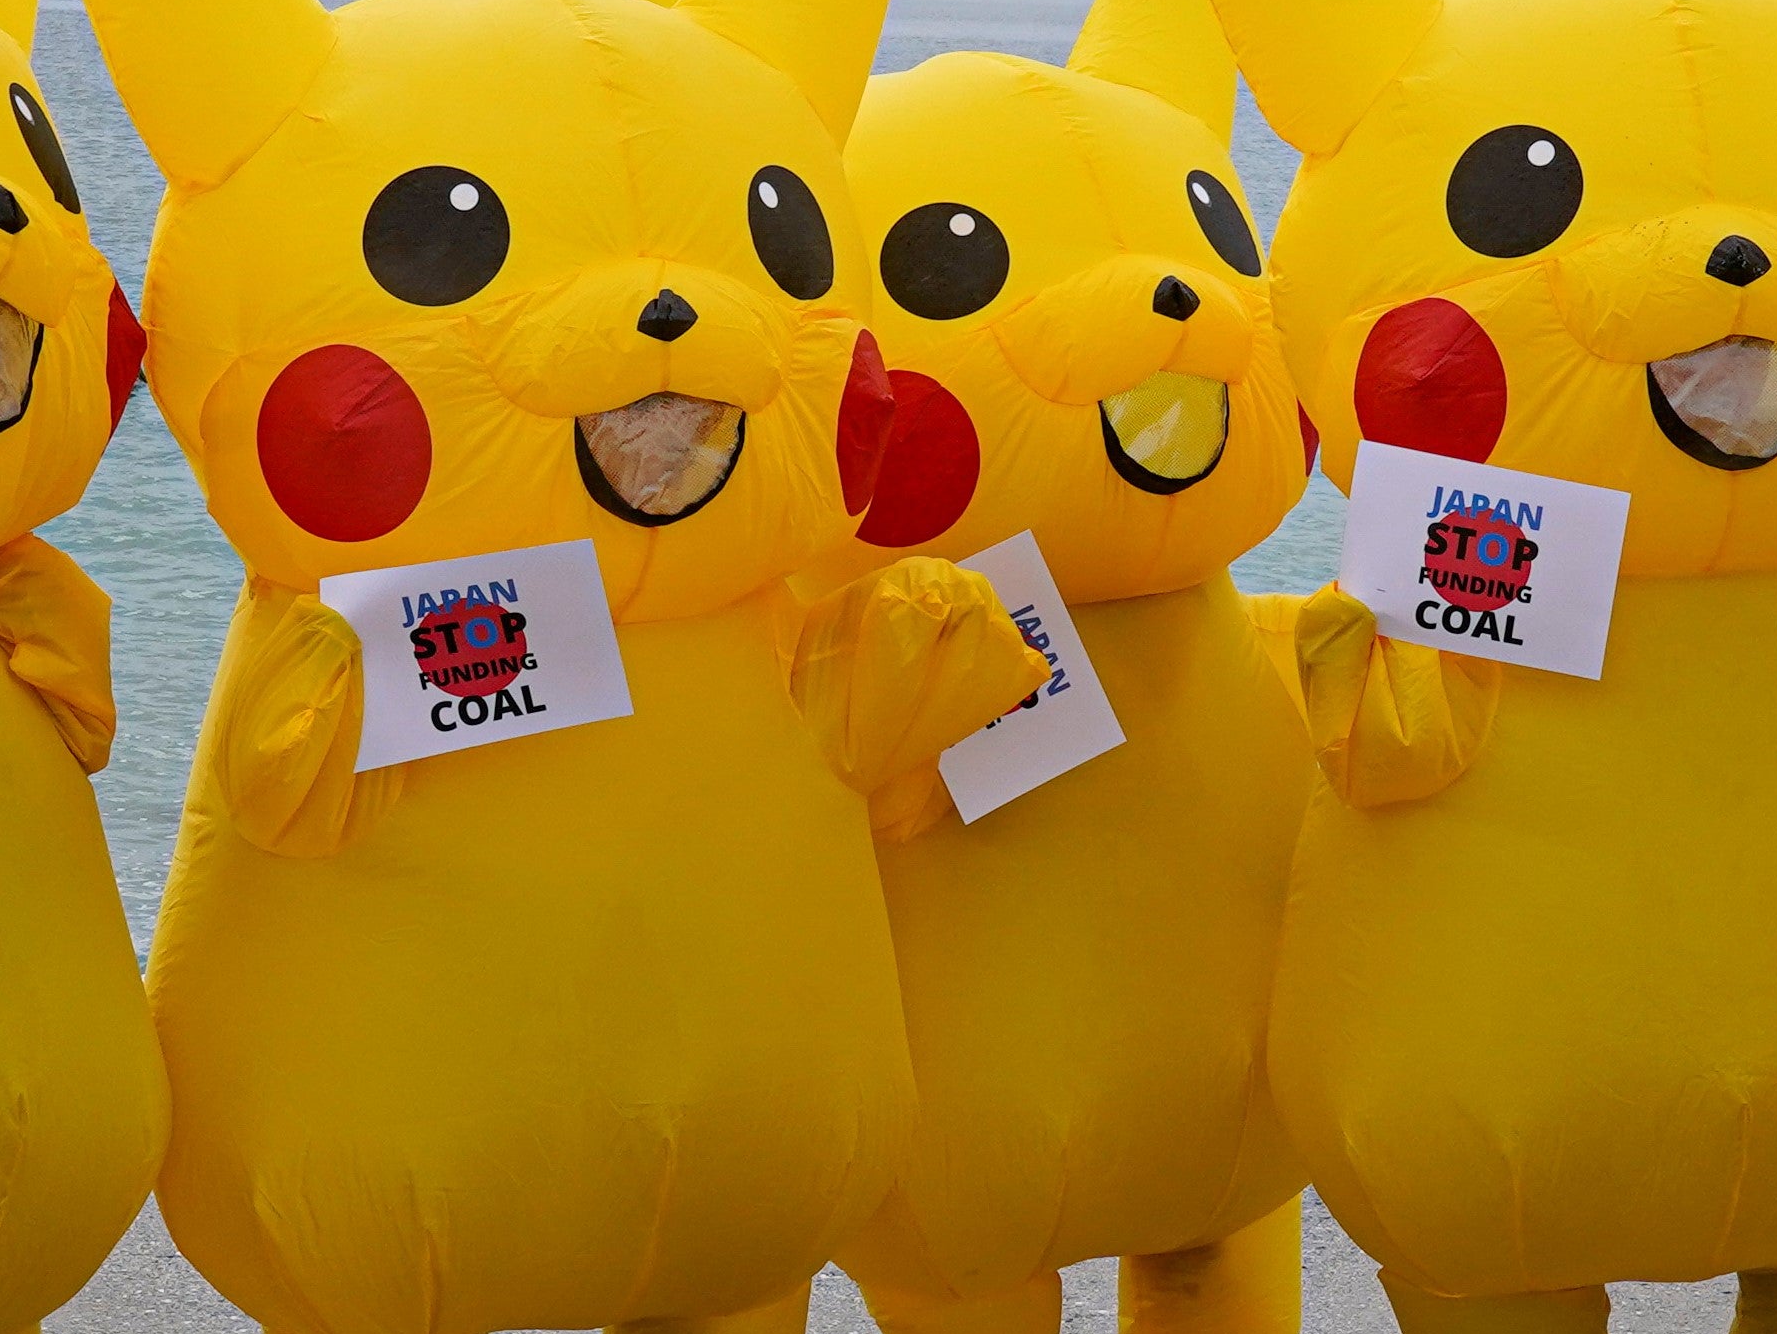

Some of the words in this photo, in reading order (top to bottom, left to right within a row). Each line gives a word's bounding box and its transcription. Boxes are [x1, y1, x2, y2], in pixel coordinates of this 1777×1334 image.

[1426, 486, 1543, 531] JAPAN
[1424, 522, 1539, 571] STOP
[402, 579, 519, 628] JAPAN
[1418, 567, 1533, 603] FUNDING
[409, 612, 527, 659] STOP
[1415, 600, 1523, 646] COAL
[419, 653, 538, 690] FUNDING
[431, 685, 546, 732] COAL
